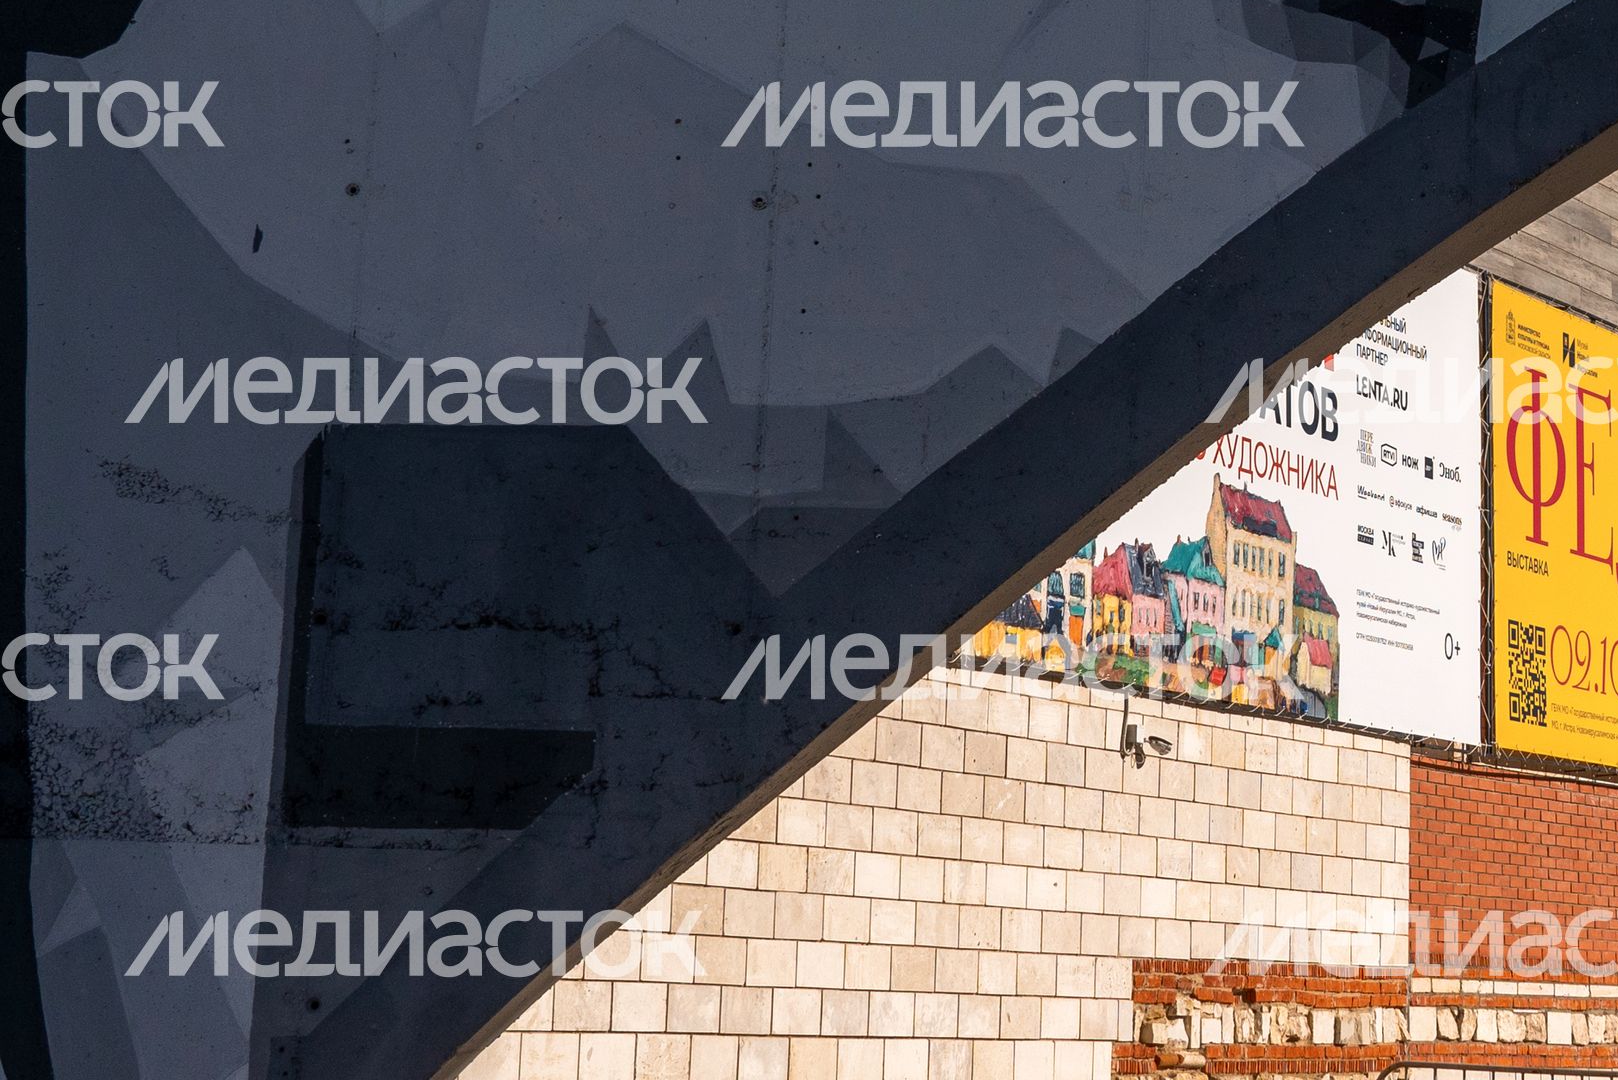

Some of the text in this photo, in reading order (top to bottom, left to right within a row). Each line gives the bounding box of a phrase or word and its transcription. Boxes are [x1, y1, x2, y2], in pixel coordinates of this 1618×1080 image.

[1356, 374, 1409, 411] LENTA.RU
[1506, 552, 1549, 577] ВЫСТАВКА
[1444, 631, 1461, 660] 0+
